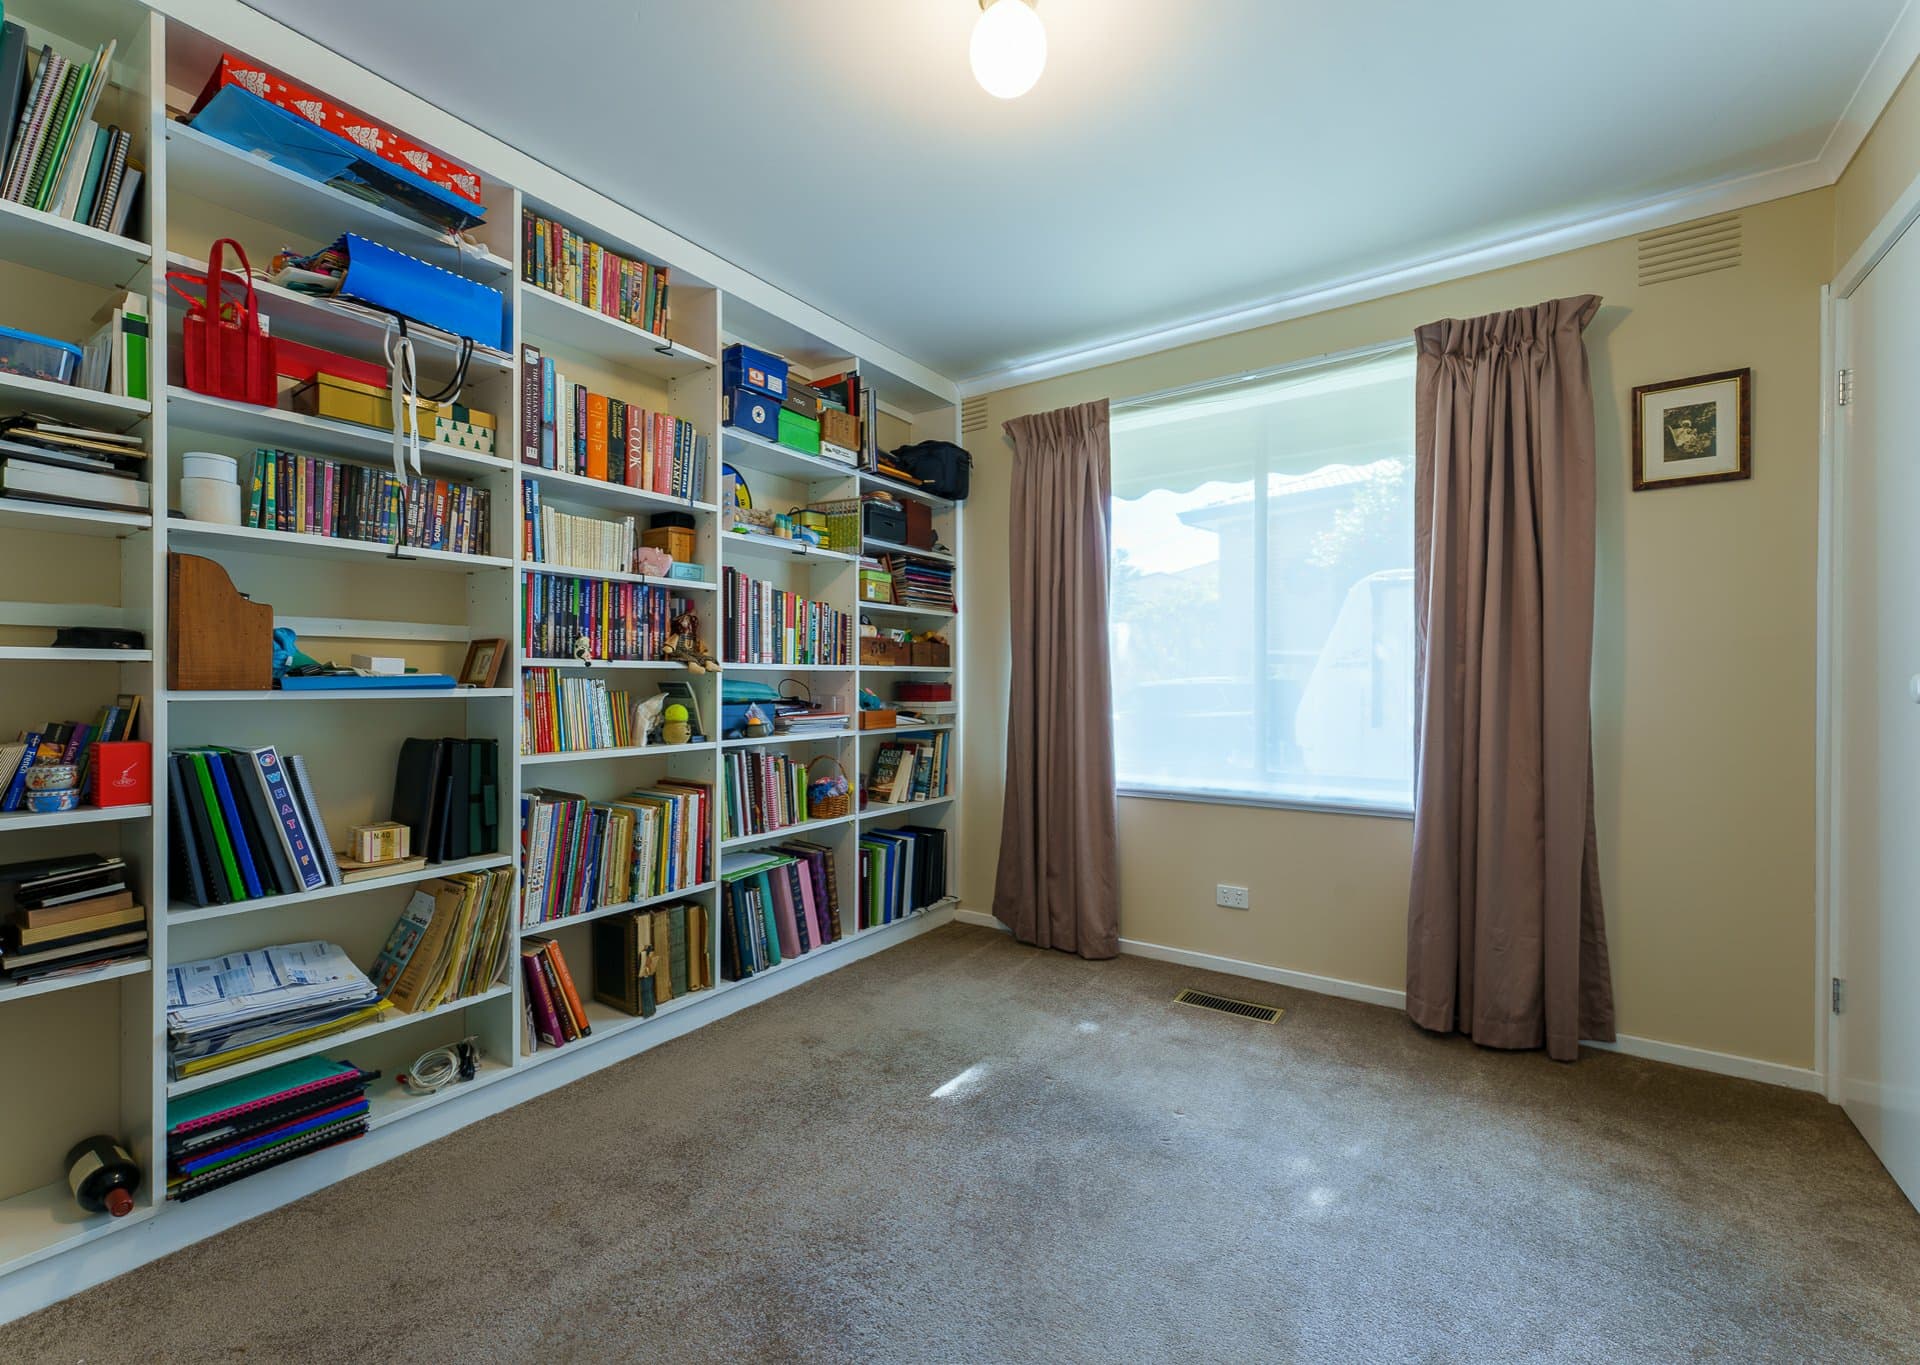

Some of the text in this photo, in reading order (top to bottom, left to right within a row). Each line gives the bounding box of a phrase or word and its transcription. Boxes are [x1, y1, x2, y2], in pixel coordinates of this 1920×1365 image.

[629, 427, 642, 469] COOK
[672, 457, 680, 491] JAMIE
[434, 494, 444, 542] SOUND RELIEF
[19, 750, 36, 774] French
